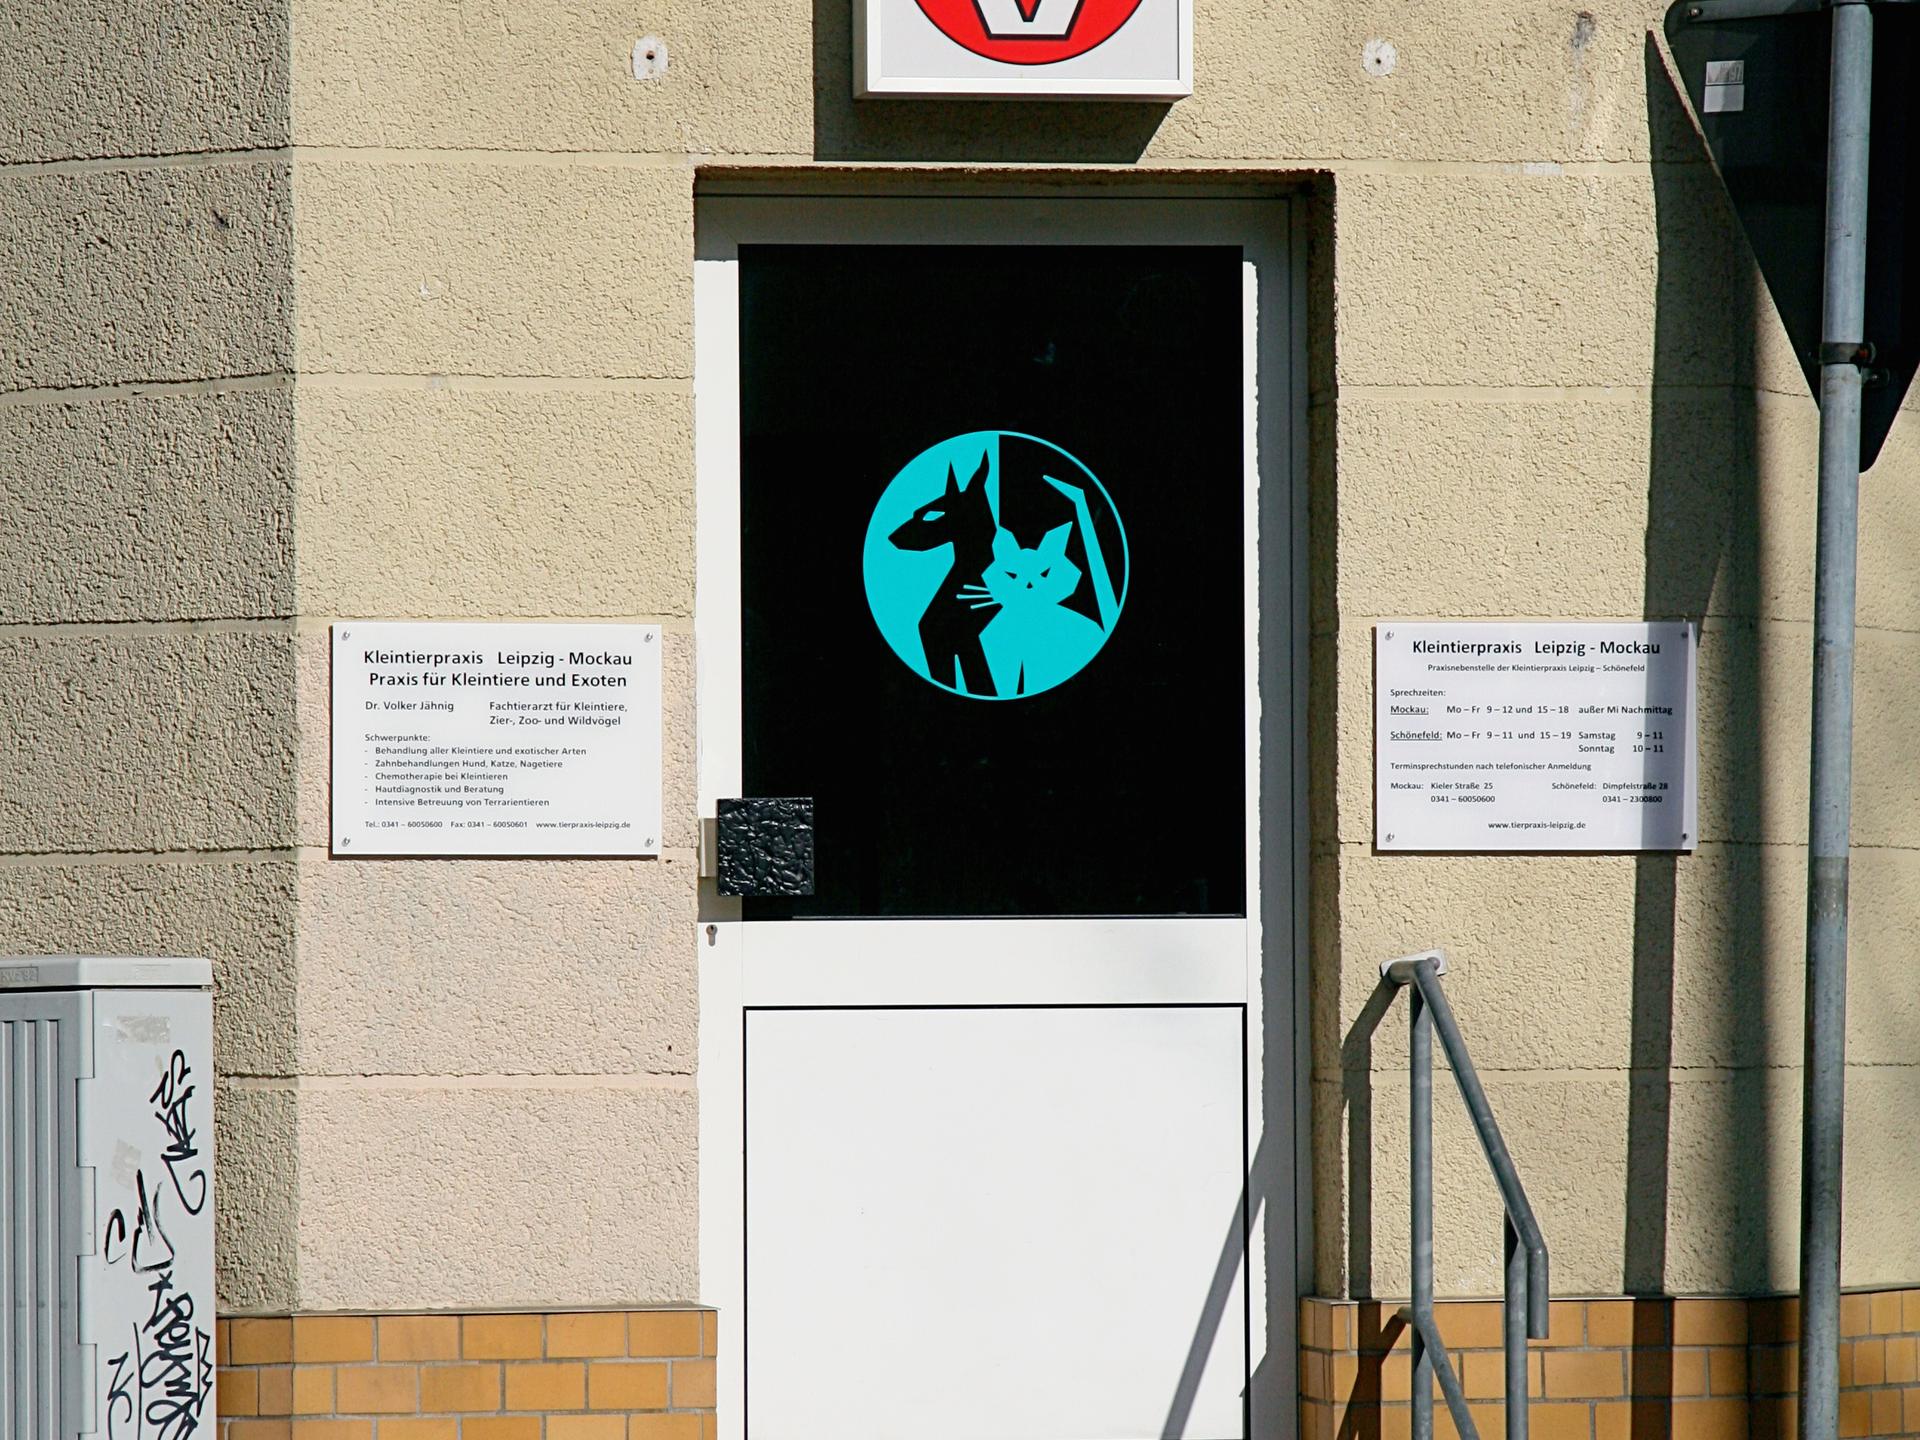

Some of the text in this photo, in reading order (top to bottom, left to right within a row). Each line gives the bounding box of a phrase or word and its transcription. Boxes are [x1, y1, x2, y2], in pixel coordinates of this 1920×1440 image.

[1413, 640, 1522, 657] Kleintierpraxis
[1535, 640, 1586, 657] Leipzig
[1600, 640, 1660, 655] Mockau
[364, 649, 483, 668] Kleintierpraxis
[498, 650, 555, 669] Leipzig
[569, 651, 632, 666] Mockau
[1427, 664, 1495, 672] Praxisnebenstelle
[1496, 664, 1510, 672] der
[1511, 664, 1567, 673] Kleintierpraxis
[1568, 664, 1594, 673] Leipzig
[1602, 664, 1645, 672] Schönefeld
[369, 671, 627, 688] Praxis für Kleintiere und Exoten
[1390, 688, 1446, 698] Sprechzeiten:
[365, 700, 454, 713] Dr. Volker Jähnig
[489, 701, 628, 714] Fachtierarzt für Kleintiere,
[1390, 705, 1429, 716] Mockau:
[1446, 705, 1462, 714] Mo
[1471, 705, 1481, 714] Fr
[1486, 705, 1493, 714] 9
[1502, 705, 1513, 714] 12
[1515, 705, 1533, 714] und
[1537, 705, 1549, 714] 15
[1558, 705, 1569, 714] 18
[1578, 705, 1605, 714] außer
[1606, 705, 1619, 714] Mi
[1621, 705, 1673, 716] Nachmittag
[489, 714, 621, 728] Zier-, Zoo- und Wildvögel
[364, 733, 431, 744] Schwerpunkte:
[1390, 730, 1443, 742] Schönefeld:
[1446, 731, 1462, 739] Mo
[1471, 731, 1481, 739] Fr
[1486, 731, 1493, 739] 9
[1502, 731, 1513, 740] 11
[1517, 731, 1535, 739] und
[1540, 731, 1551, 740] 15
[1561, 731, 1572, 740] 19
[1578, 731, 1616, 742] Samstag
[1637, 731, 1643, 740] 9
[1653, 731, 1663, 740] 11
[375, 746, 587, 757] Behandlung aller Kleintiere und exotischer Arten
[1578, 743, 1615, 755] Sonntag
[1633, 744, 1644, 753] 10
[1653, 744, 1664, 753] 11
[375, 759, 563, 770] Zahnbehandlungen Hund, Katze, Nagetiere
[1390, 761, 1592, 772] Terminsprechstunden nach telefonischer Anmeldung
[375, 771, 508, 783] Chemotherapie bei Kleintieren
[375, 785, 504, 795] Hautdiagnostik und Beratung
[1390, 782, 1494, 790] Mockau: Kieler Straße 25
[1552, 782, 1668, 792] Schönefeld: Dimpfelstraße 28
[375, 798, 415, 806] Intensive
[417, 798, 464, 808] Betreuung
[483, 798, 550, 807] Terrarientieren
[1430, 795, 1450, 803] 0341
[1457, 795, 1496, 803] 60050600
[1602, 795, 1621, 803] 0341
[1629, 795, 1663, 803] 2300800
[493, 821, 527, 829] 60050601
